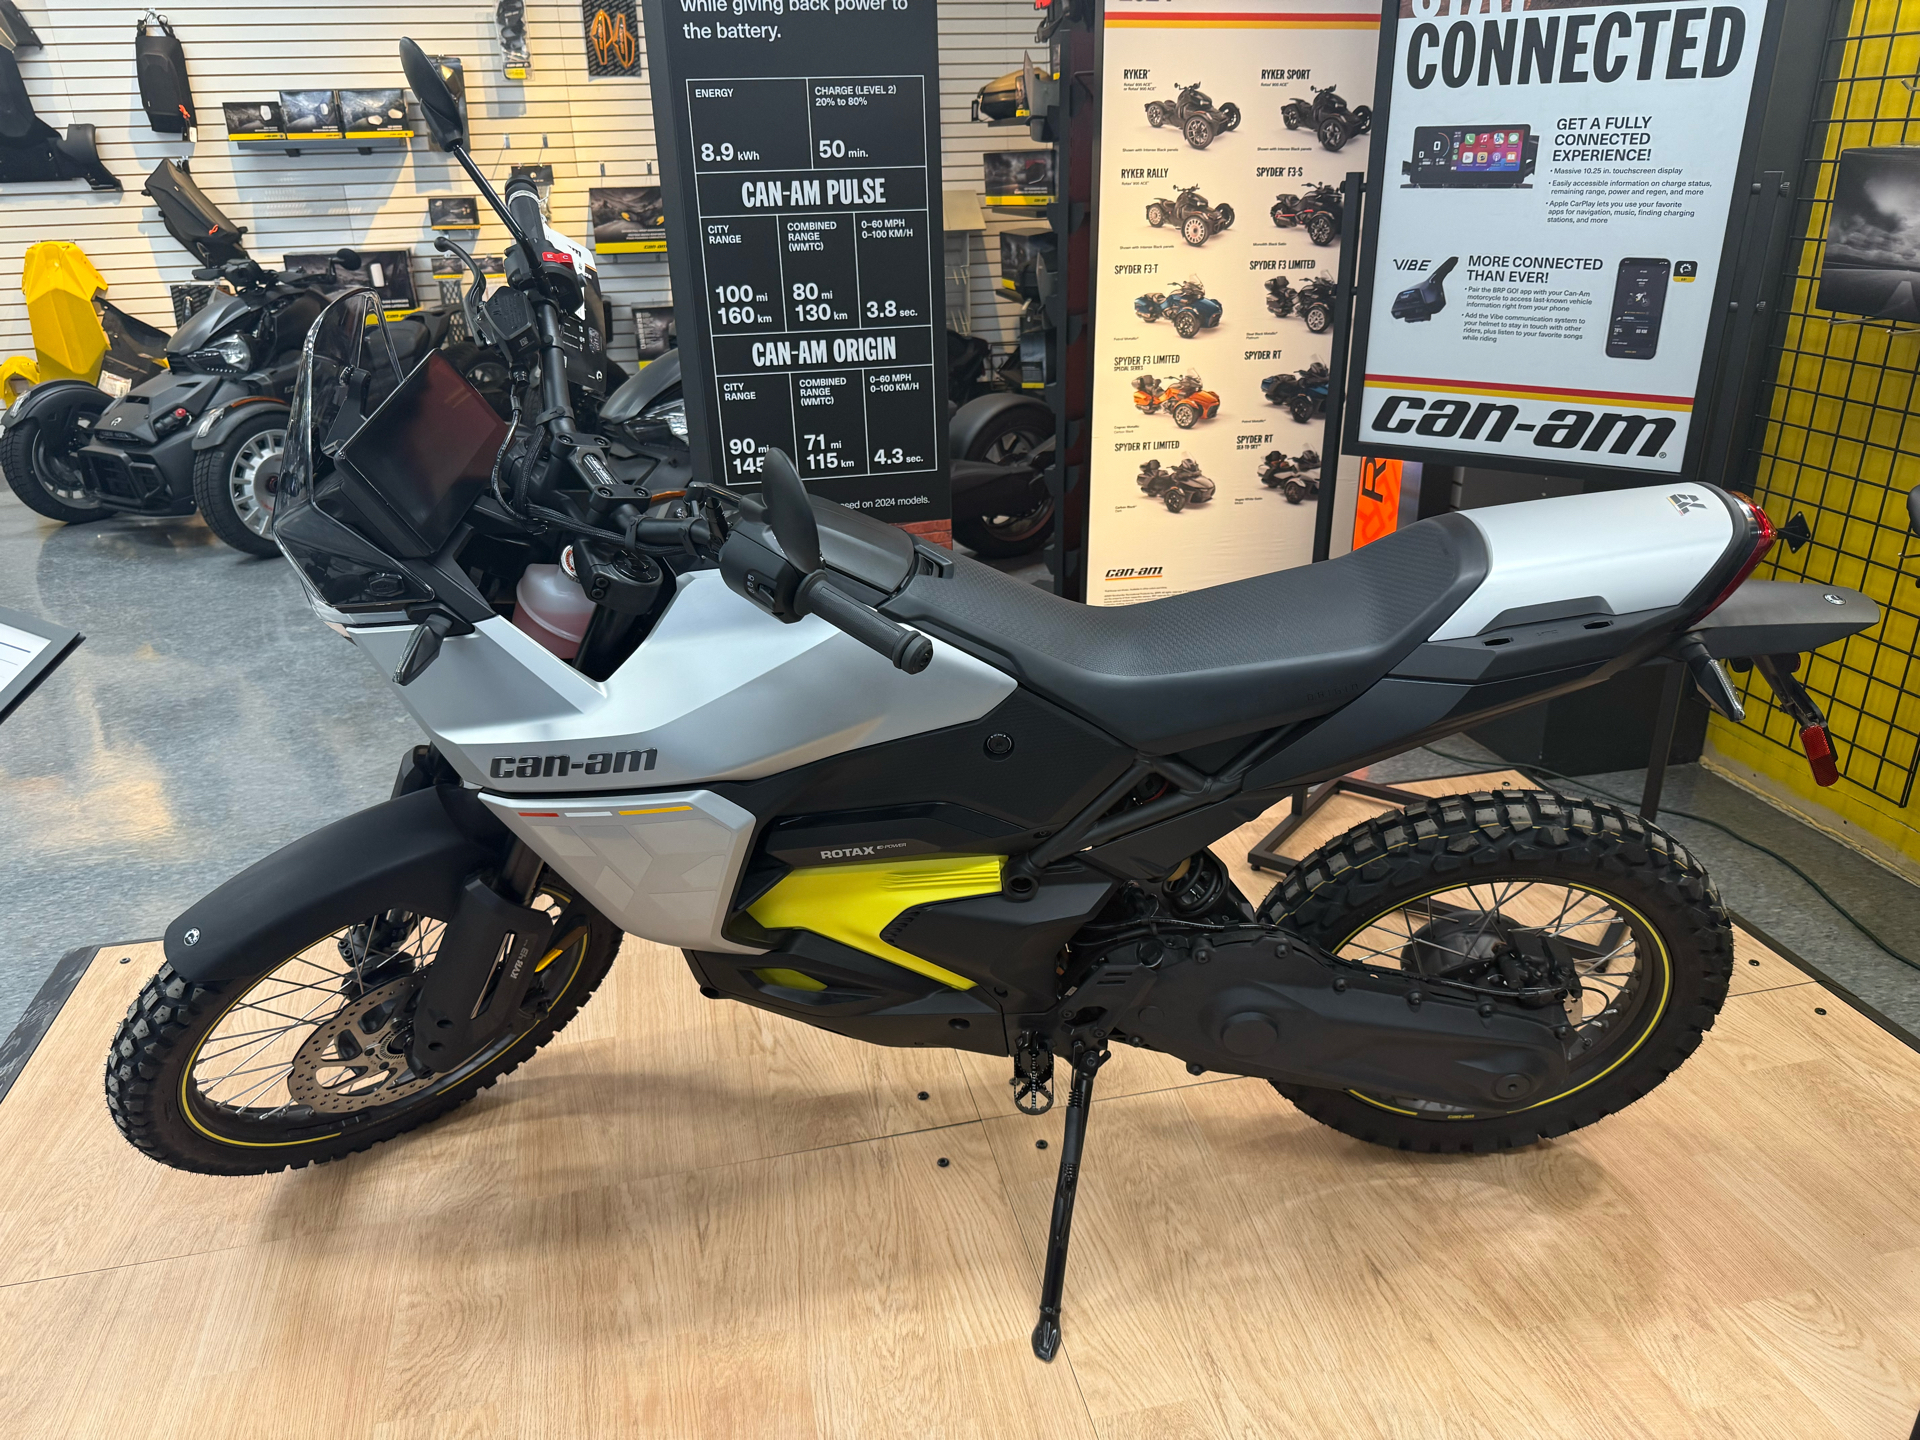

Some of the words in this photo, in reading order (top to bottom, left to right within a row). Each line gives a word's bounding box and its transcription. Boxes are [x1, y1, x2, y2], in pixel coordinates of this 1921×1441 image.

[732, 0, 783, 15] giving
[789, 0, 830, 11] back
[835, 0, 887, 14] power
[892, 0, 908, 10] to
[683, 22, 711, 39] the
[716, 22, 781, 42] battery.
[1407, 6, 1746, 89] CONNECTED
[1261, 69, 1285, 79] RYKER
[1287, 69, 1311, 80] SPORT
[695, 88, 733, 98] ENERGY
[815, 86, 853, 95] CHARGE
[855, 85, 886, 95] (LEVEL
[888, 85, 896, 94] 2)
[816, 97, 835, 106] 20%
[837, 98, 846, 106] to
[848, 97, 867, 106] 80%
[1557, 117, 1588, 130] GET
[1589, 117, 1601, 130] A
[1605, 116, 1652, 129] FULLY
[1555, 133, 1651, 146] CONNECTED
[701, 143, 734, 161] 8.9
[737, 151, 760, 161] kWh
[819, 140, 845, 158] 50
[848, 148, 868, 158] min.
[1552, 149, 1651, 162] EXPERIENCE!
[1121, 168, 1145, 178] RYKER
[1147, 168, 1169, 178] RALLY
[1288, 167, 1303, 177] F3-S
[1657, 167, 1683, 175] display
[1552, 180, 1572, 188] Easily
[1661, 180, 1687, 188] charge
[742, 180, 821, 208] CAN-AM
[826, 178, 886, 205] PULSE
[1549, 200, 1569, 208] Apple
[1570, 200, 1596, 208] CarPlay
[1614, 209, 1637, 217] music,
[1638, 209, 1662, 217] finding
[1663, 210, 1695, 218] charging
[787, 221, 837, 231] COMBINED
[884, 219, 905, 227] MPH
[708, 225, 729, 234] CITY
[888, 228, 913, 238] KM/H
[709, 235, 742, 244] RANGE
[788, 232, 820, 241] RANGE
[789, 242, 824, 252] (WMTC)
[1249, 260, 1277, 270] SPYDER
[1278, 260, 1287, 270] F3
[1288, 259, 1316, 269] LIMITED
[1393, 259, 1432, 271] VIBE
[1468, 255, 1510, 267] MORE
[1513, 256, 1603, 270] CONNECTED
[1114, 264, 1142, 275] SPYDER
[1144, 264, 1158, 274] F3-T
[1467, 269, 1505, 282] THAN
[1509, 271, 1549, 283] EVER!
[715, 285, 753, 303] 100
[756, 292, 768, 302] mi
[793, 283, 818, 300] 80
[821, 290, 833, 299] mi
[718, 306, 755, 324] 160
[757, 314, 772, 323] km
[795, 303, 831, 321] 130
[833, 311, 848, 320] km
[867, 300, 897, 318] 3.8
[899, 309, 918, 317] sec.
[752, 340, 827, 367] CAN-AM
[833, 336, 896, 363] ORIGIN
[1244, 350, 1271, 360] SPYDER
[1272, 350, 1282, 359] RT
[1114, 356, 1141, 366] SPYDER
[1143, 355, 1151, 365] F3
[1153, 354, 1180, 364] LIMITED
[799, 377, 847, 387] COMBINED
[892, 373, 911, 382] MPH
[723, 383, 744, 391] CITY
[800, 387, 831, 397] RANGE
[896, 382, 919, 391] KM/H
[725, 391, 756, 401] RANGE
[801, 396, 834, 406] (WMTC)
[804, 434, 825, 450] 71
[830, 440, 842, 449] mi
[1236, 434, 1263, 444] SPYDER
[1264, 434, 1273, 443] RT
[729, 438, 755, 455] 90
[758, 444, 770, 453] mi
[1114, 442, 1141, 452] SPYDER
[1142, 442, 1151, 450] RT
[1153, 440, 1180, 450] LIMITED
[807, 452, 838, 469] 115
[874, 448, 903, 464] 4.3
[875, 498, 895, 507] 2024
[897, 495, 930, 505] models.
[1105, 566, 1163, 578] can-am
[489, 747, 658, 779] can-am
[820, 846, 875, 859] ROTAX
[510, 960, 523, 979] KYB
